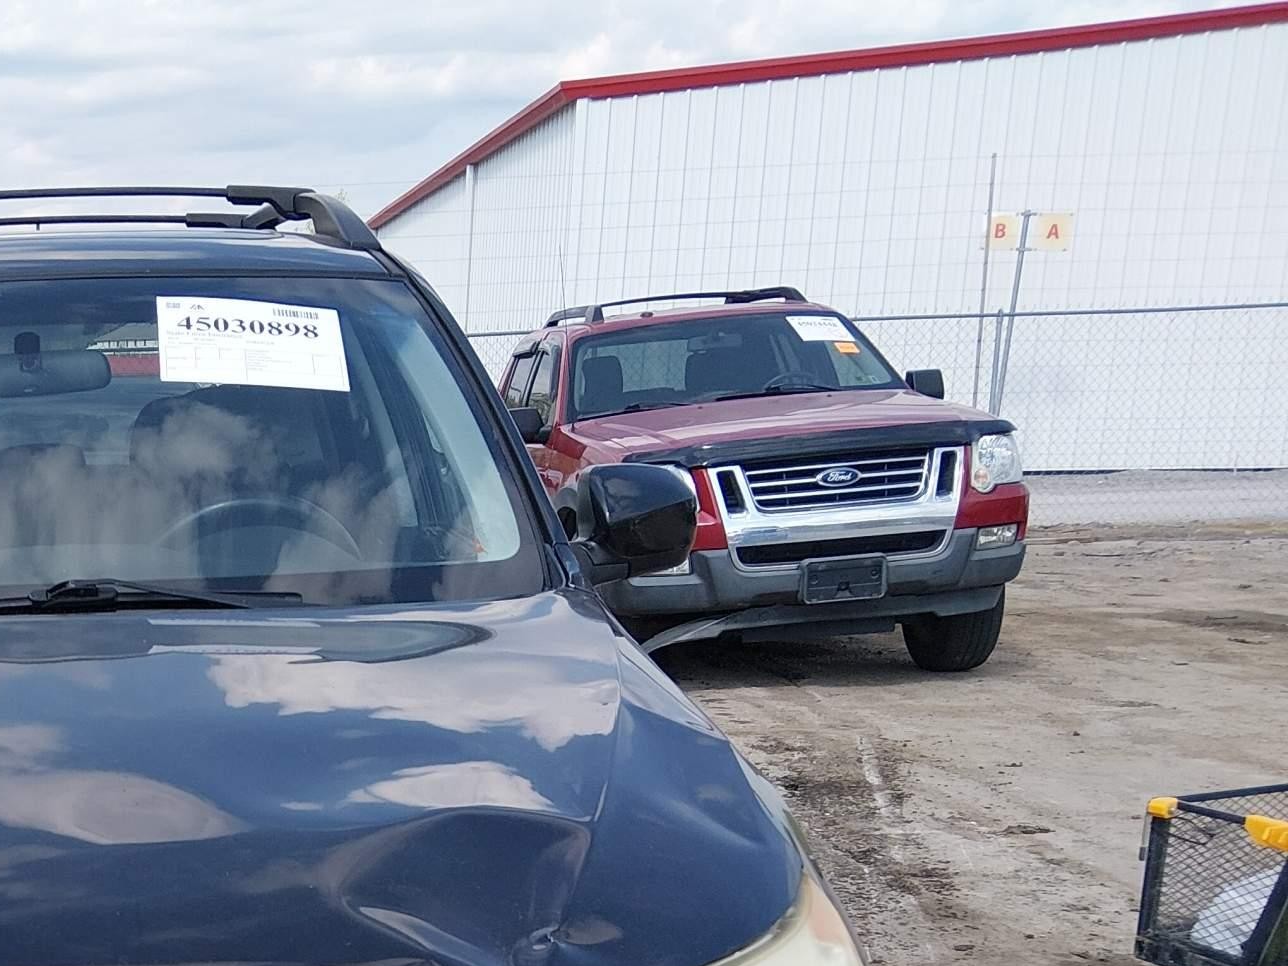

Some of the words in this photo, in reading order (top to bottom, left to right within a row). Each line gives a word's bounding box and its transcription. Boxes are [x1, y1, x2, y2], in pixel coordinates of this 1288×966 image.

[994, 223, 1006, 239] B
[1046, 223, 1059, 239] A
[176, 315, 320, 340] 45030898
[827, 471, 853, 482] Ford
